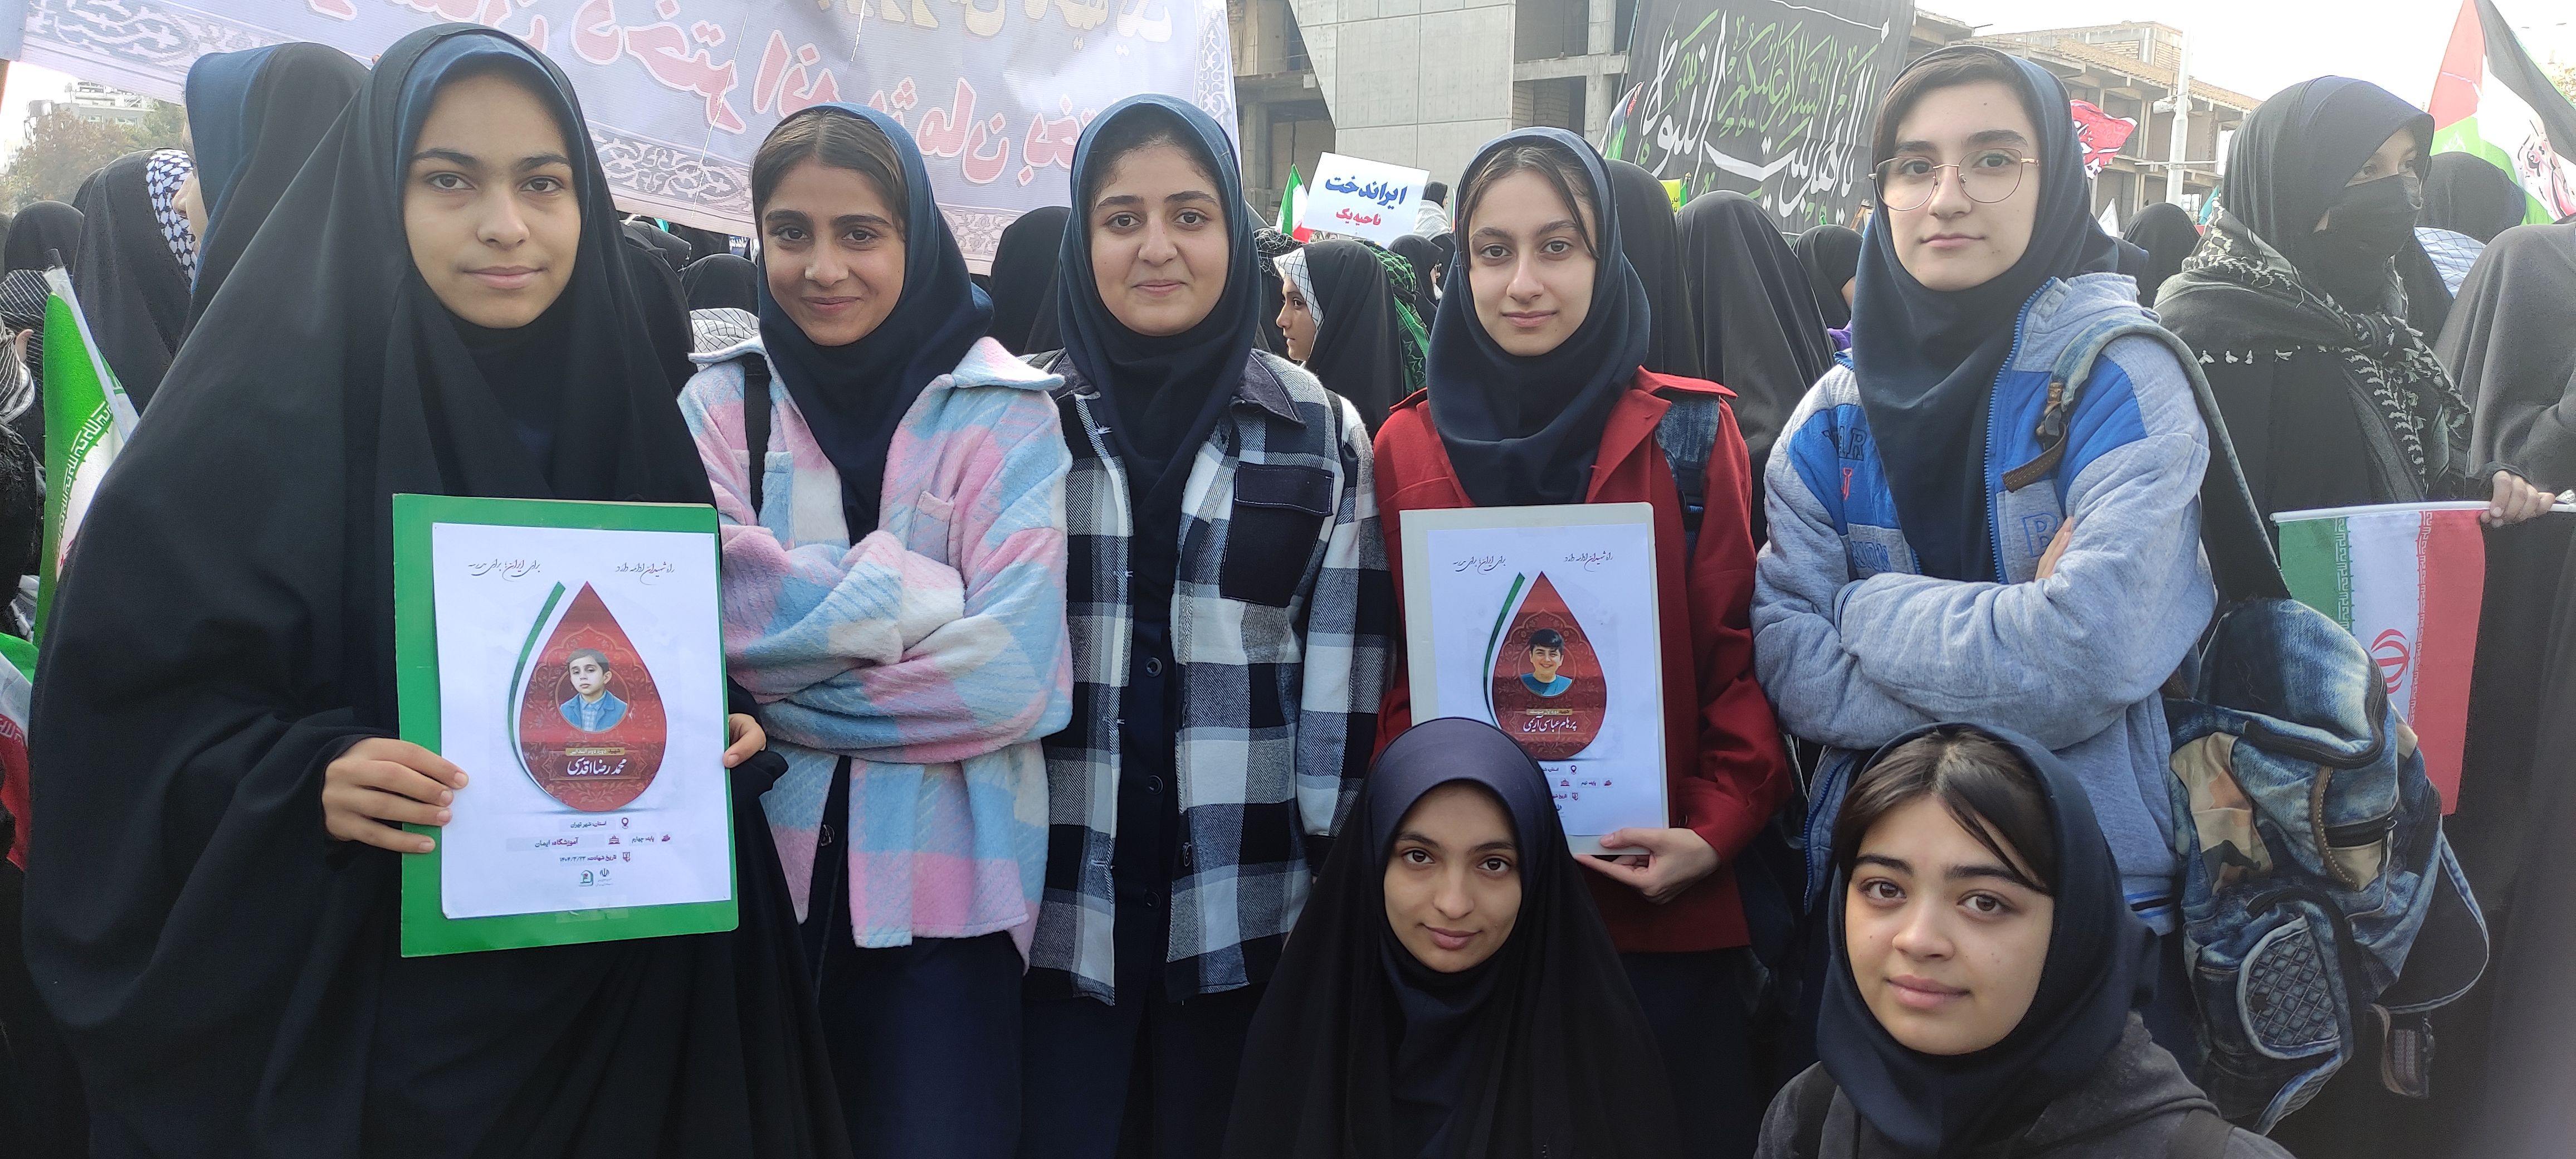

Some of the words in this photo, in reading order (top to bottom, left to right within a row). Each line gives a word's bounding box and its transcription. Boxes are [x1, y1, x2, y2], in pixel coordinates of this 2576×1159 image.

[1325, 176, 1408, 210] ایراندخت
[1336, 208, 1353, 223] یک
[1353, 213, 1382, 226] ناحیه
[471, 558, 502, 576] برای
[508, 559, 540, 577] برای
[615, 562, 628, 572] دارد
[630, 563, 645, 572] ادامه
[666, 563, 675, 573] راه
[1455, 556, 1477, 572] برای
[1484, 556, 1506, 572] برای
[640, 562, 666, 585] شهیدان
[1539, 718, 1560, 733] عباسی
[1558, 716, 1577, 738] پرهام
[567, 757, 593, 775] اقدسی
[593, 759, 611, 775] رضا
[611, 758, 627, 775] محمد
[535, 839, 550, 848] ایمان
